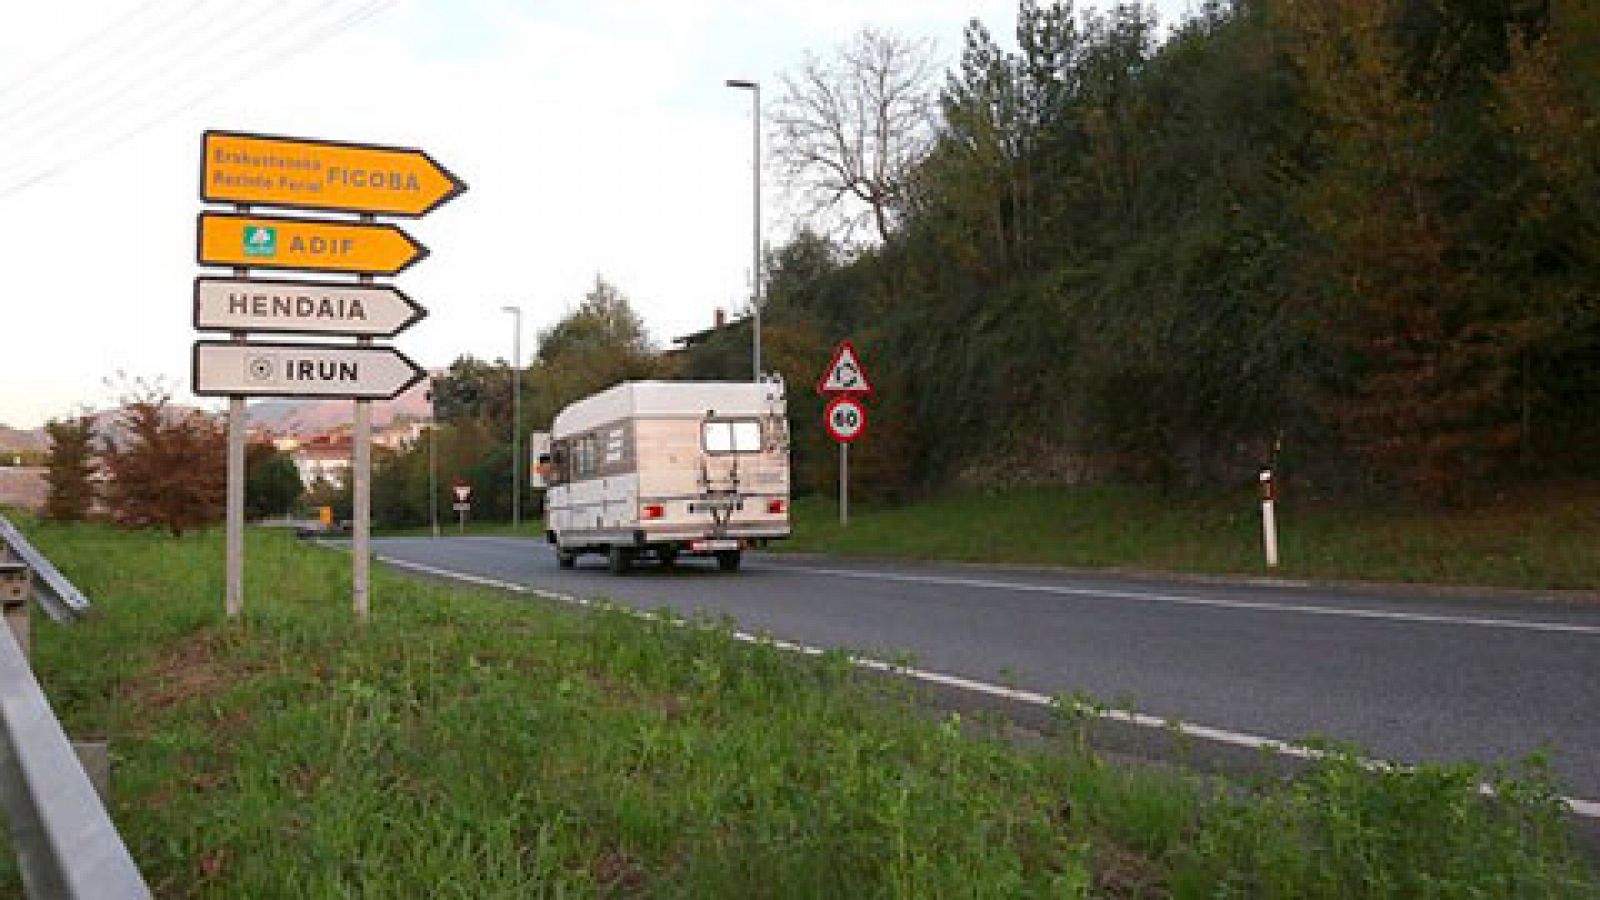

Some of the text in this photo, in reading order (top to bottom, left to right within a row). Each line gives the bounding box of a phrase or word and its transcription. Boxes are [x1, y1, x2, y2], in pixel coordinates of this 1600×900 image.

[326, 166, 421, 191] FICOBA
[289, 236, 354, 254] ADIF
[229, 293, 367, 320] HENDAIA
[286, 359, 358, 381] IRUN
